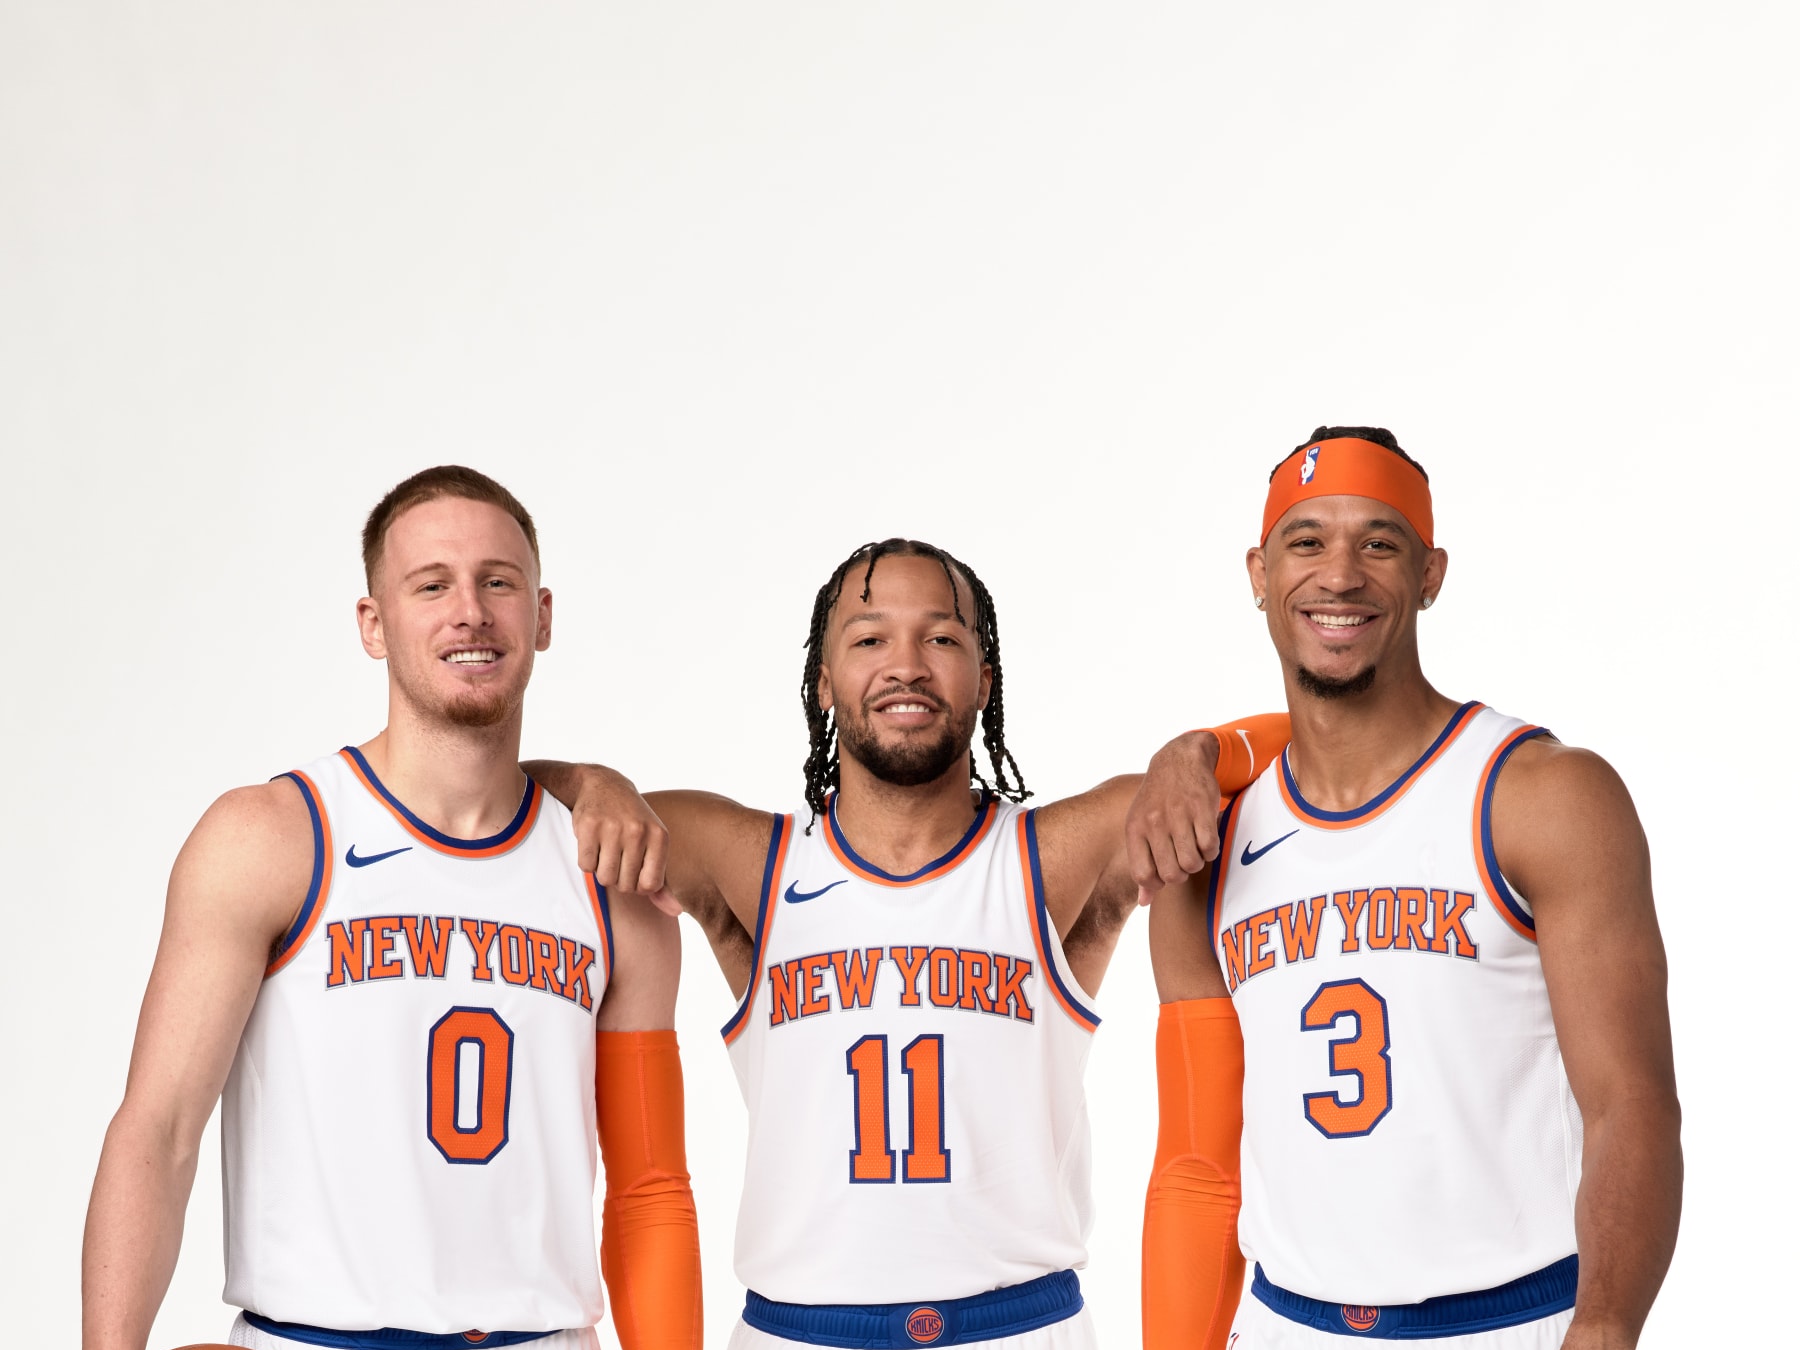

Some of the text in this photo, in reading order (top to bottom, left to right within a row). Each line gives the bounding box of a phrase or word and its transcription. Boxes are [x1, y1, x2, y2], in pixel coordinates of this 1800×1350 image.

[325, 913, 597, 1016] NEW YORK
[768, 944, 1035, 1030] NEW YORK
[1221, 886, 1480, 995] NEW YORK
[427, 1006, 515, 1165] 0
[846, 1034, 951, 1184] 11
[1300, 977, 1393, 1139] 3
[910, 1317, 940, 1334] KNICKS
